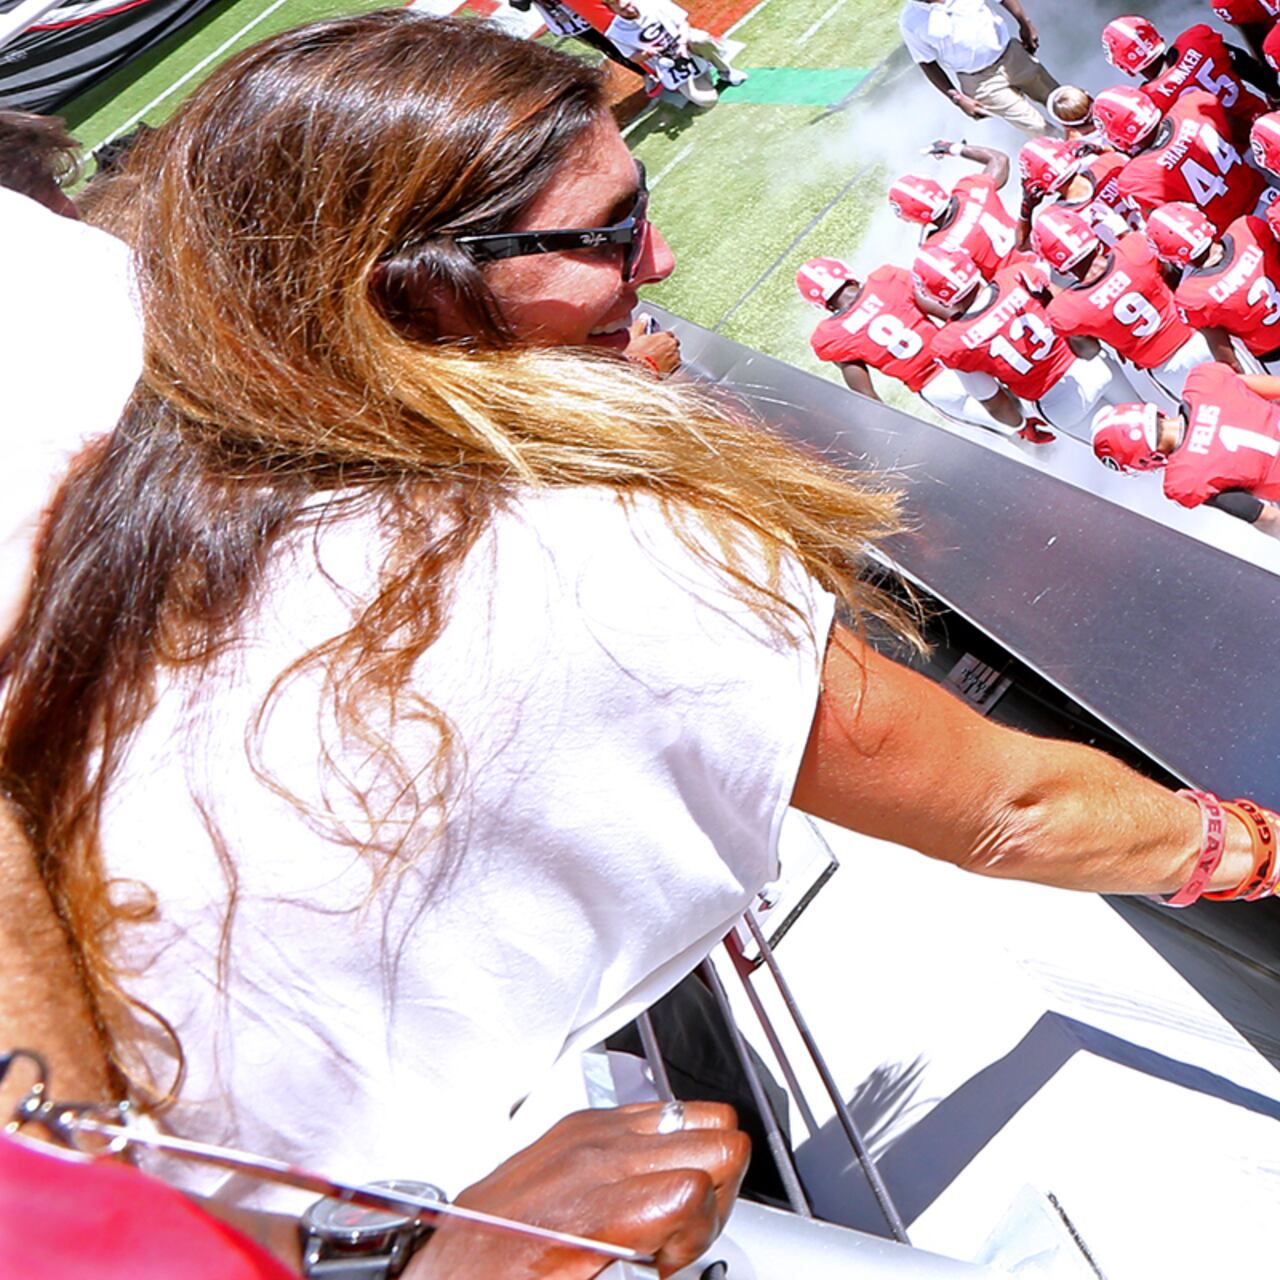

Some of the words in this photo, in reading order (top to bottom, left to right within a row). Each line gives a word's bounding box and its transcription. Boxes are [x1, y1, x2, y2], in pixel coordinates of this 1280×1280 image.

[1173, 48, 1203, 82] BAKER
[1181, 123, 1242, 206] 44
[978, 211, 1018, 258] 4
[868, 314, 923, 359] 8
[1113, 292, 1161, 337] 9
[988, 312, 1056, 375] 13
[1218, 425, 1280, 457] 1
[1200, 804, 1221, 873] PEAY
